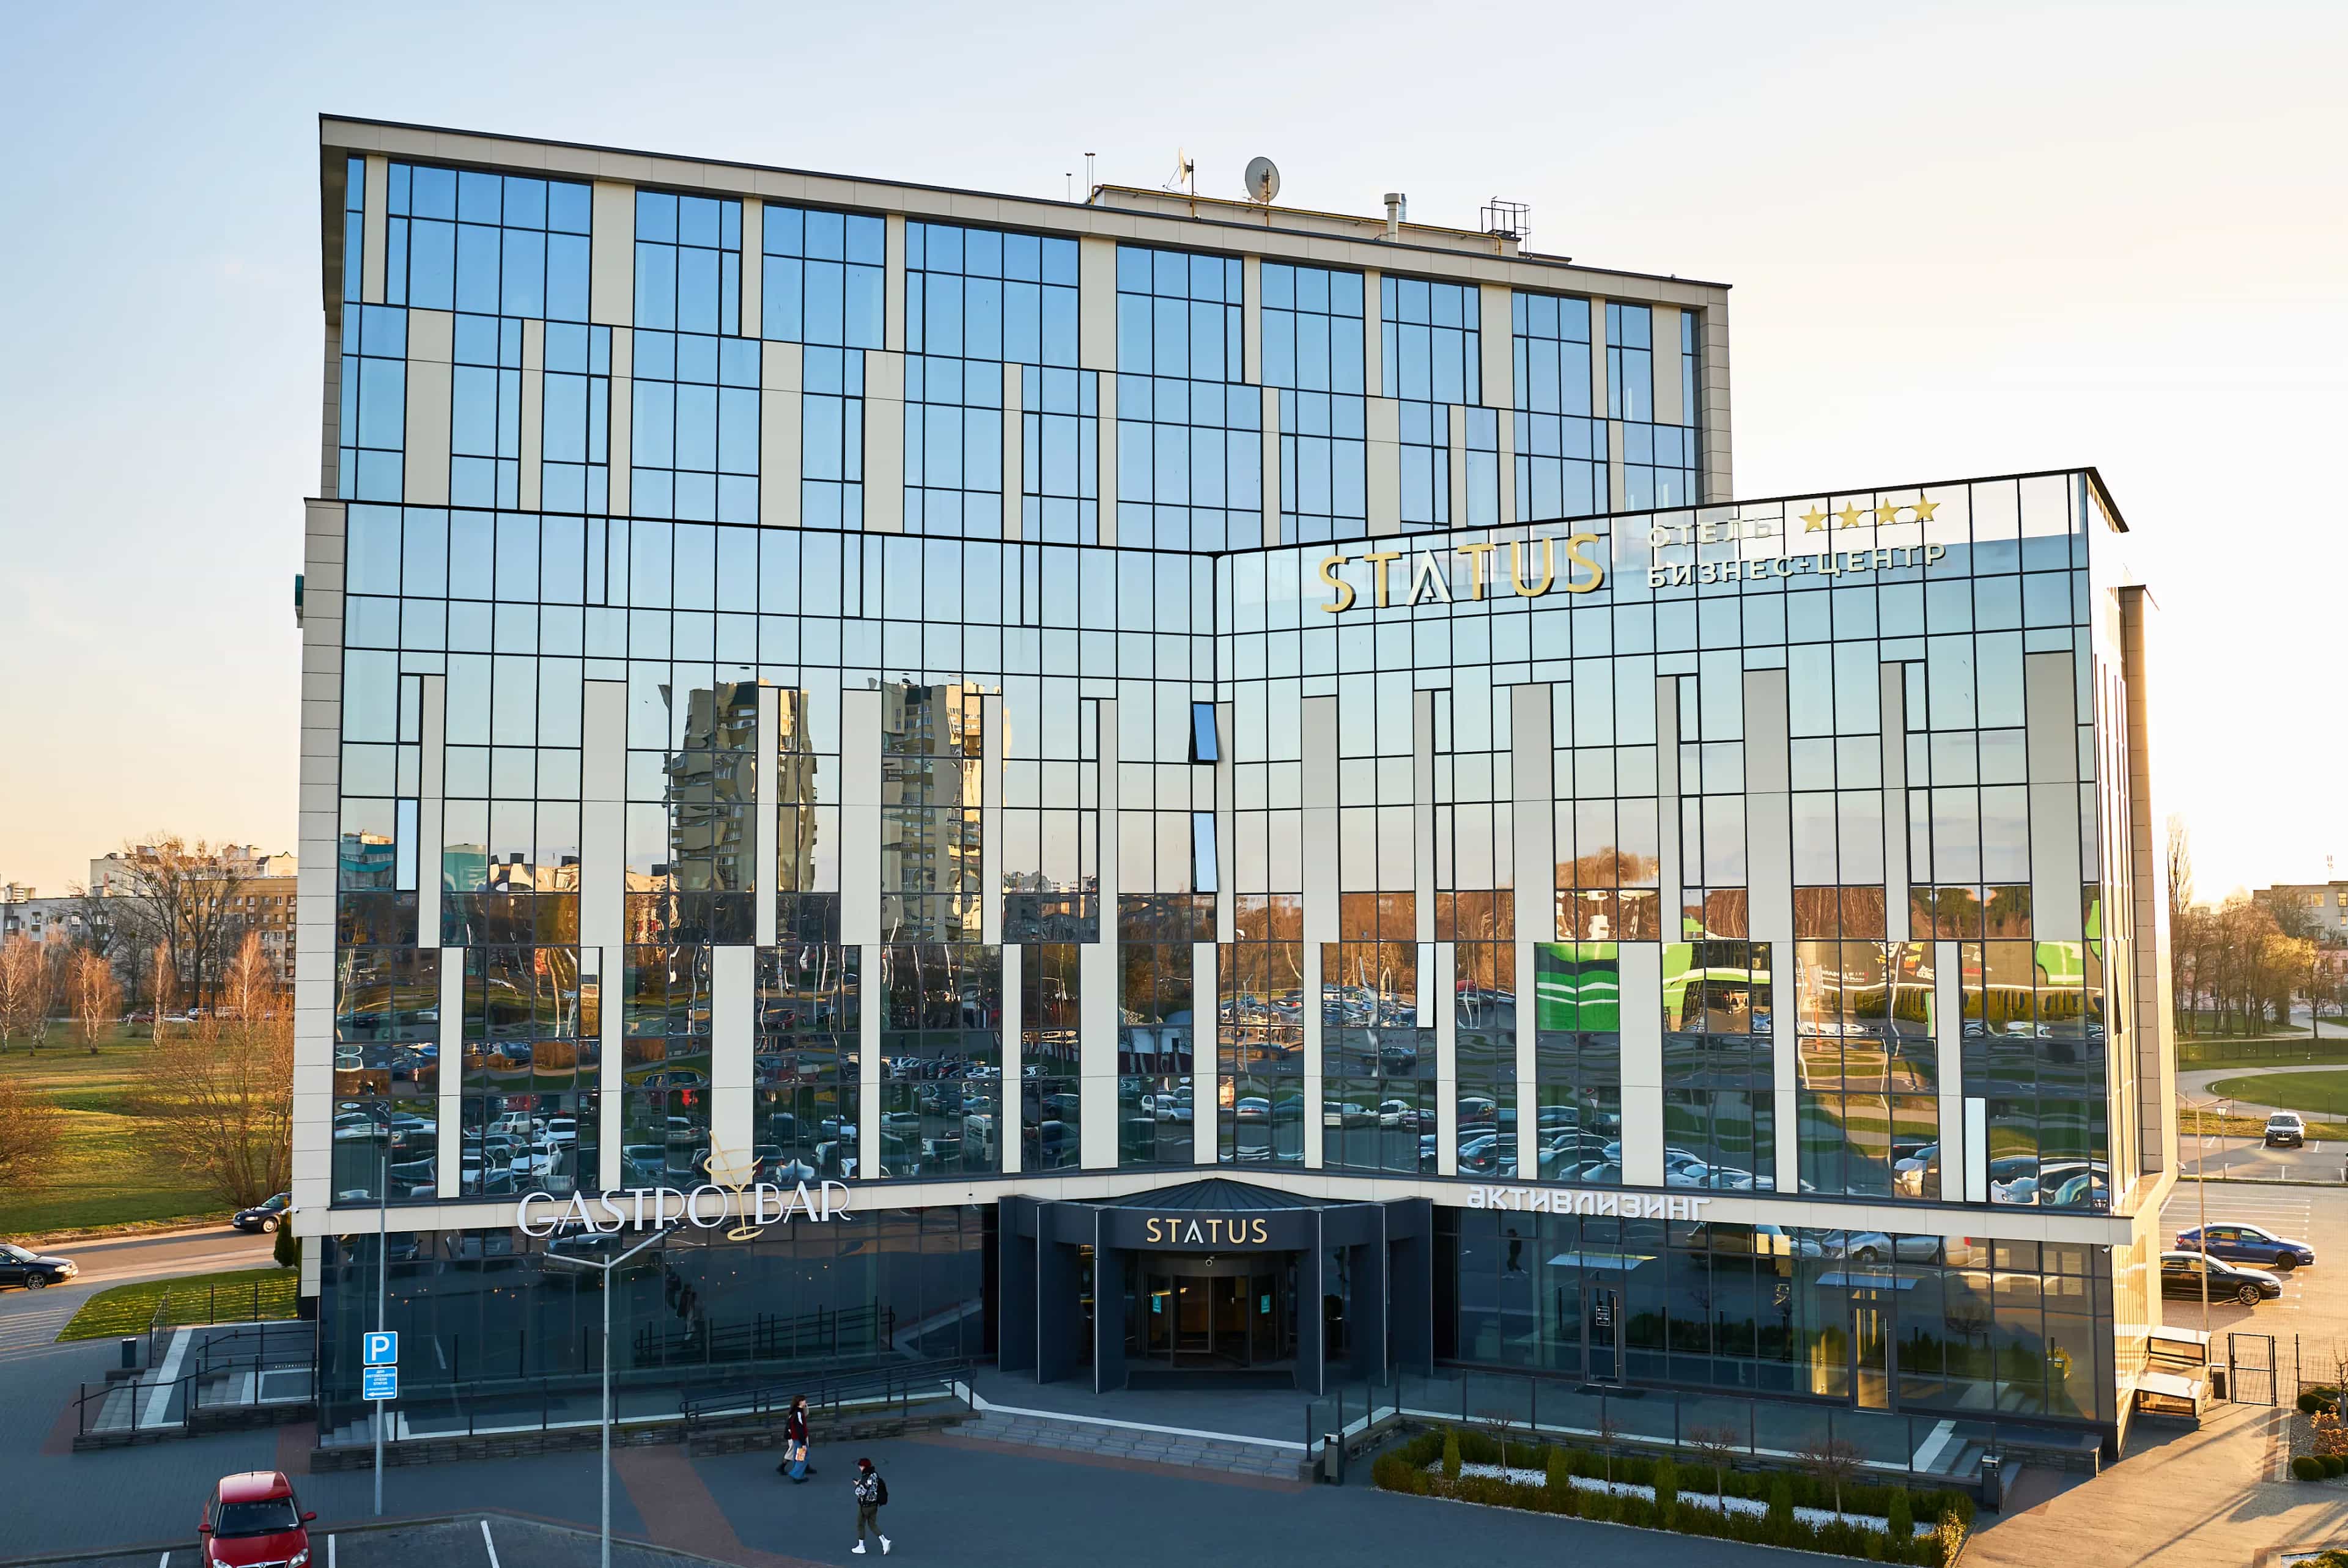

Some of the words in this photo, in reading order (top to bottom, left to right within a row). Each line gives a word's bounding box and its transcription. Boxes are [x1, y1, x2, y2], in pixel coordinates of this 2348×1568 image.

[1648, 517, 1774, 548] ОТЕЛЬ
[1319, 533, 1605, 613] STATUS
[1647, 542, 1946, 588] БИЗНЕС-ЦЕНТР
[517, 1183, 729, 1237] GASTRO
[755, 1180, 852, 1224] BAR
[1146, 1218, 1268, 1244] STATUS
[371, 1336, 389, 1361] P
